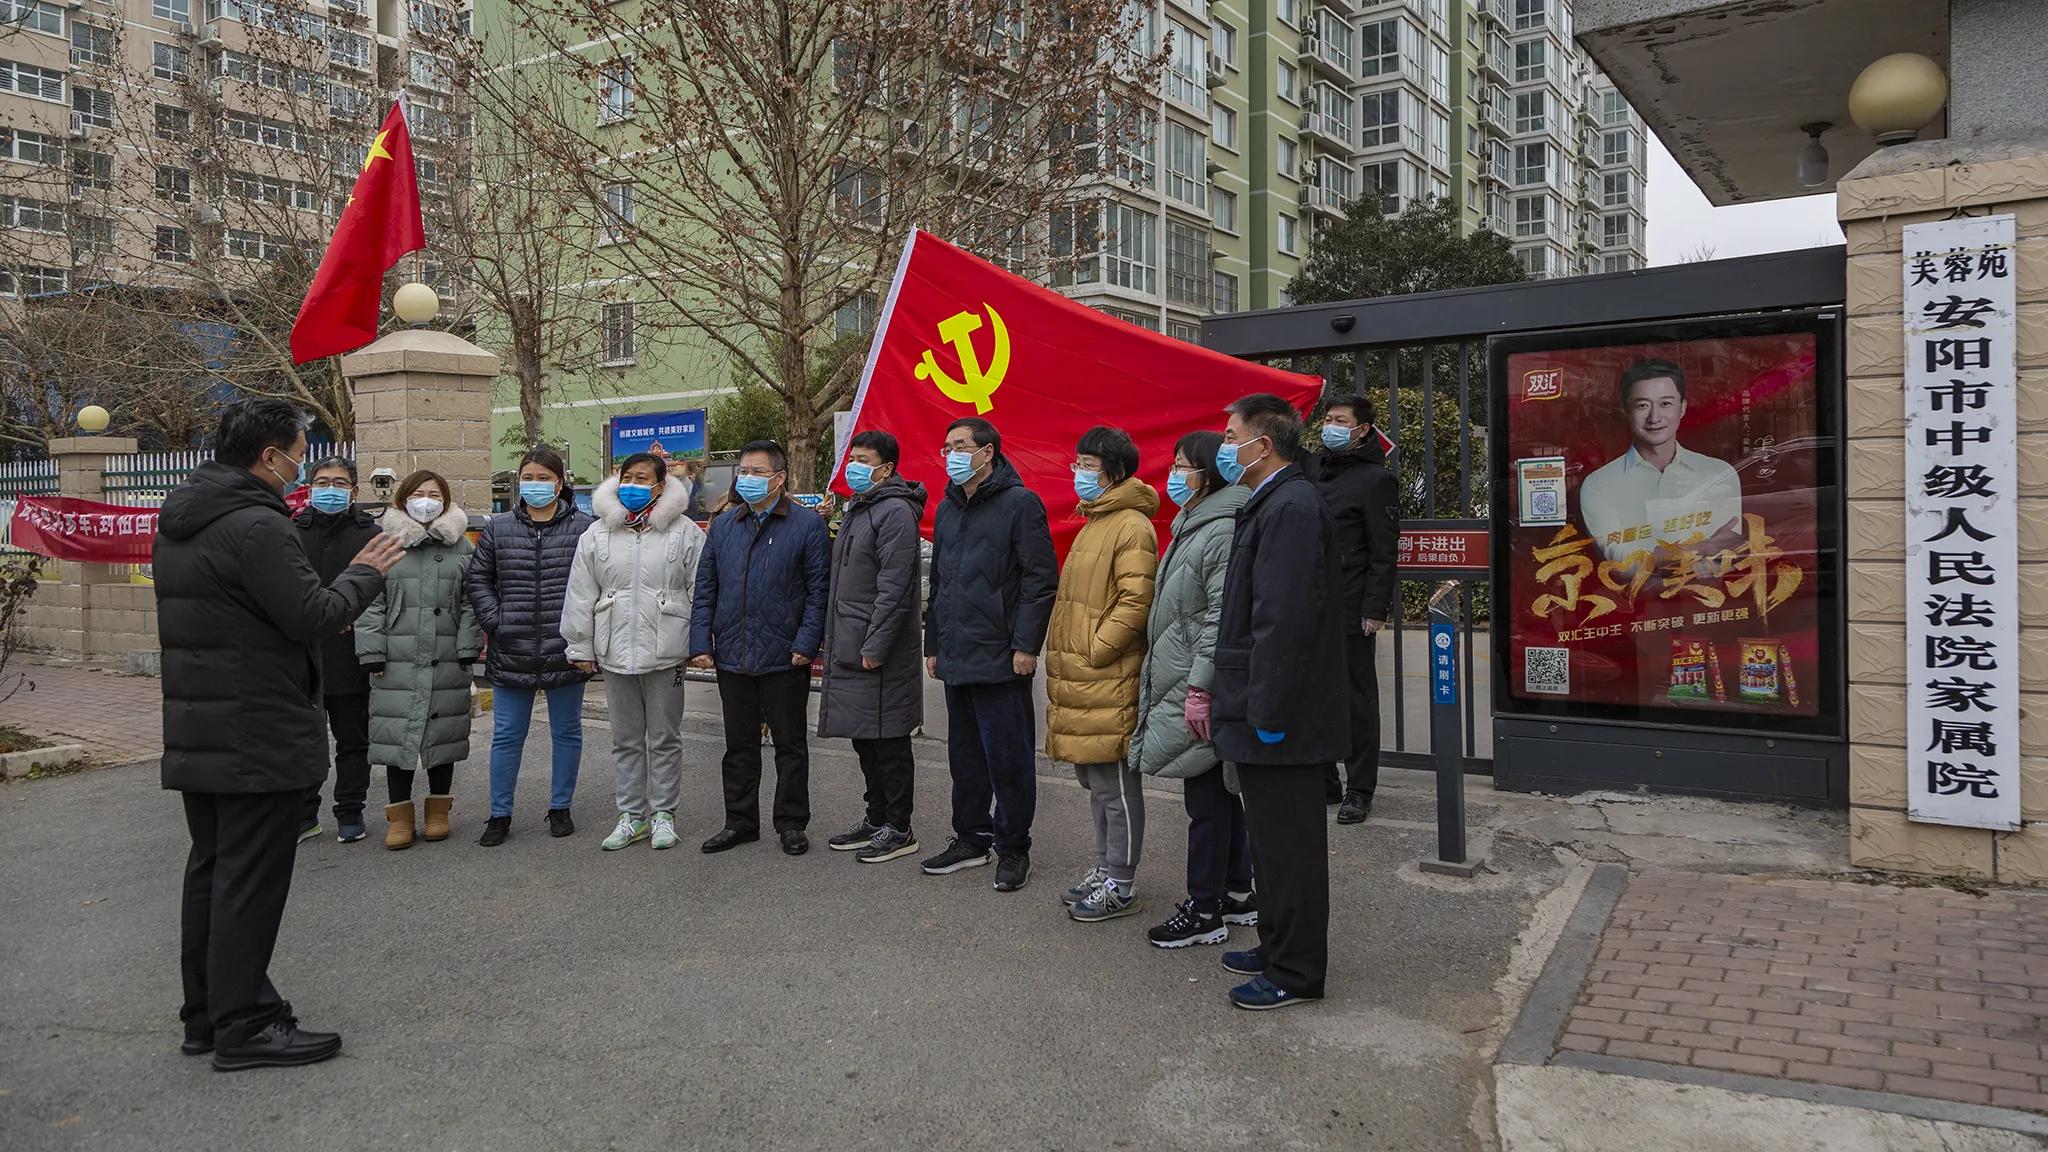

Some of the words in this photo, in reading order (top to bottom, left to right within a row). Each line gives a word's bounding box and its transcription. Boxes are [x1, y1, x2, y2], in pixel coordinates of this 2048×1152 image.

[1911, 244, 2008, 287] 芙蓉苑
[1527, 373, 1558, 391] 双汇
[658, 424, 695, 435] 共建美好家园
[1398, 536, 1466, 551] 刷卡进出
[1923, 295, 2000, 798] 安阳市中级人民法院家属院
[1558, 624, 1622, 642] 双汇王中王
[1630, 616, 1685, 633] 不断突破
[1692, 607, 1750, 625] 更新更强
